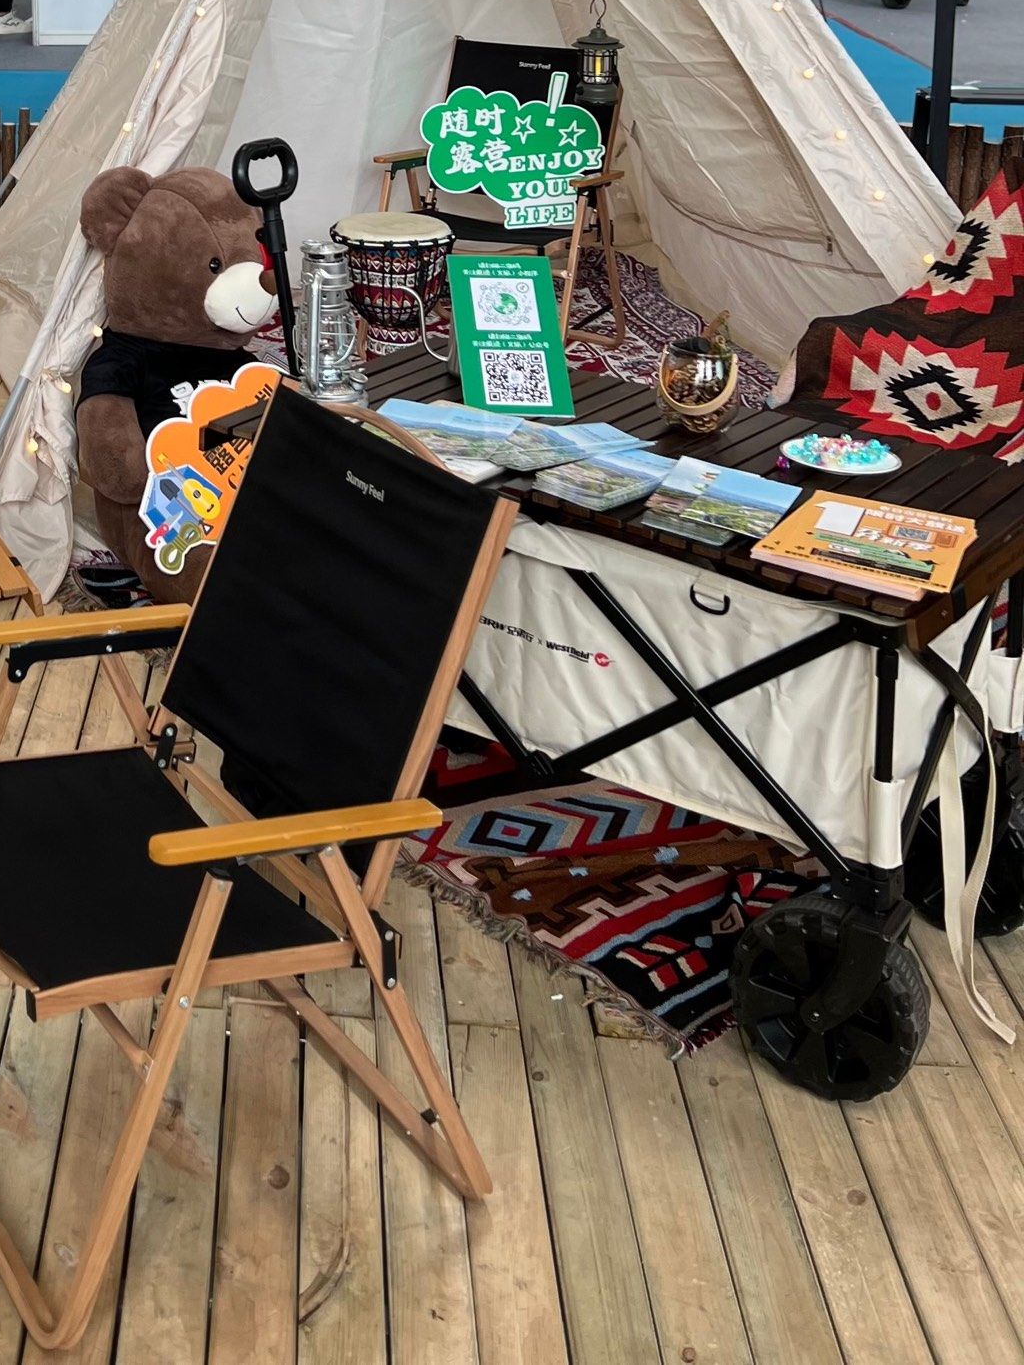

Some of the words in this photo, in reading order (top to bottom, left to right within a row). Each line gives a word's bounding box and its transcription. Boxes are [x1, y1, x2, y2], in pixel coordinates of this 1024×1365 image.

[440, 104, 506, 139] 随时
[445, 138, 512, 175] 露营
[508, 148, 604, 173] ENJOY
[507, 204, 575, 227] LIFE
[345, 470, 369, 495] Sunny
[369, 483, 385, 503] Feel
[545, 640, 590, 660] Westfield
